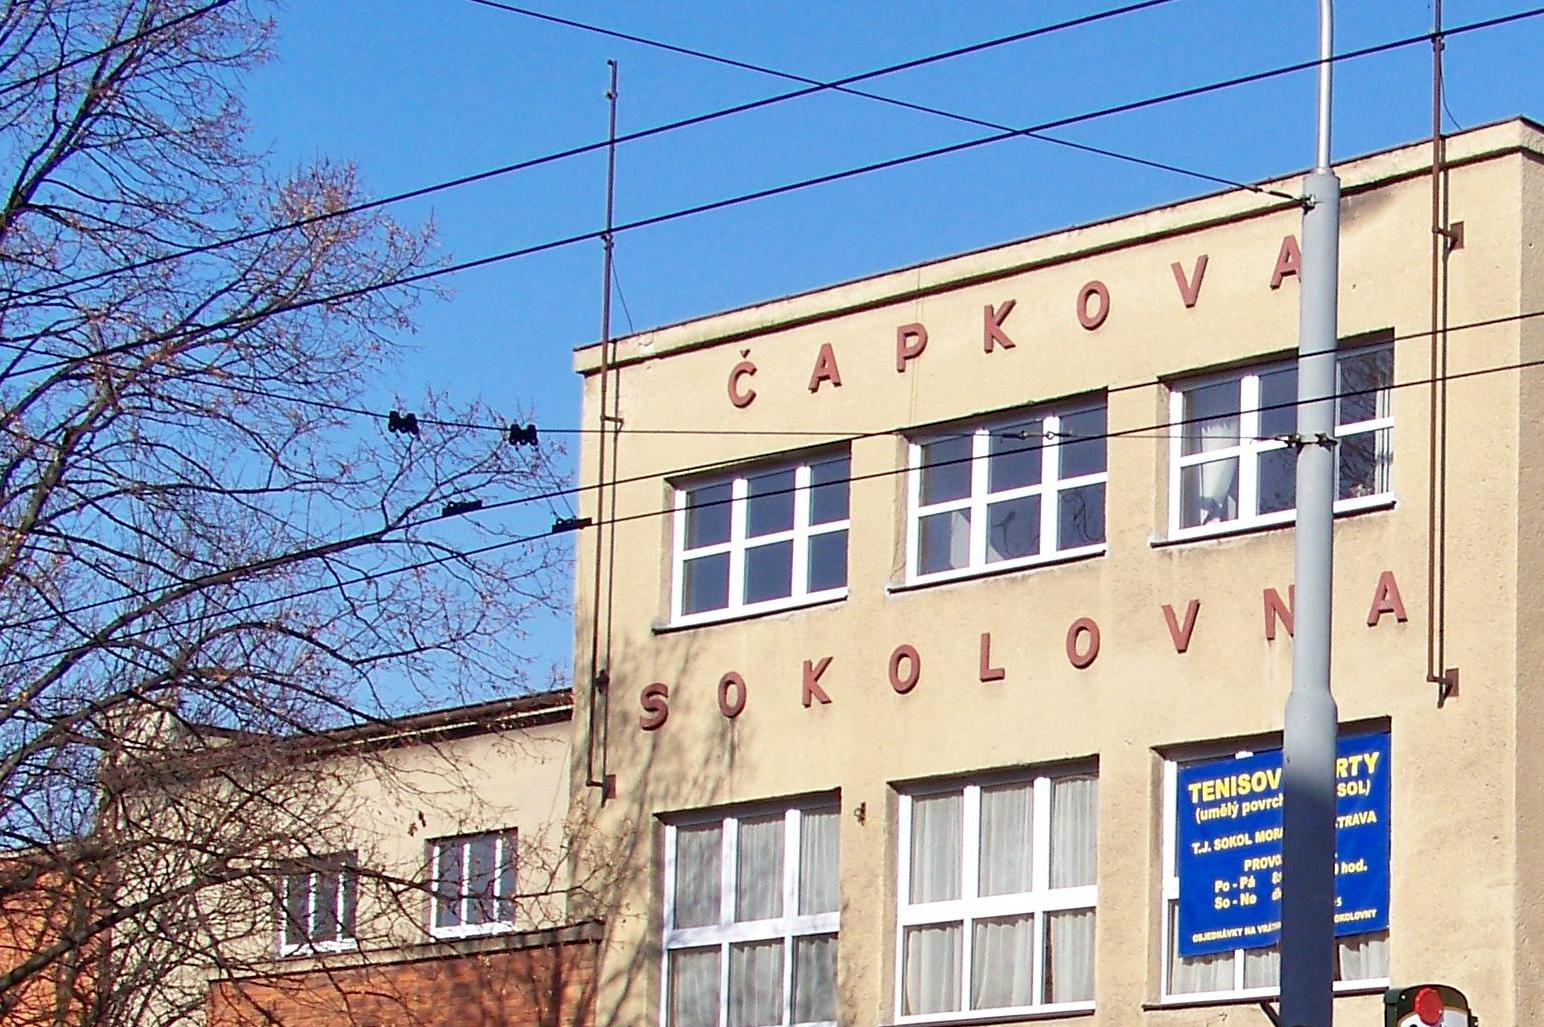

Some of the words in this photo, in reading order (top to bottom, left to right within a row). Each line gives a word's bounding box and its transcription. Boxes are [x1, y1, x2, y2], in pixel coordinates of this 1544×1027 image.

[727, 233, 1302, 408] ČAPKOVA
[639, 570, 1408, 731] SOKOLOVNA
[1188, 767, 1283, 804] TENISOV
[1213, 832, 1253, 851] SOKOL
